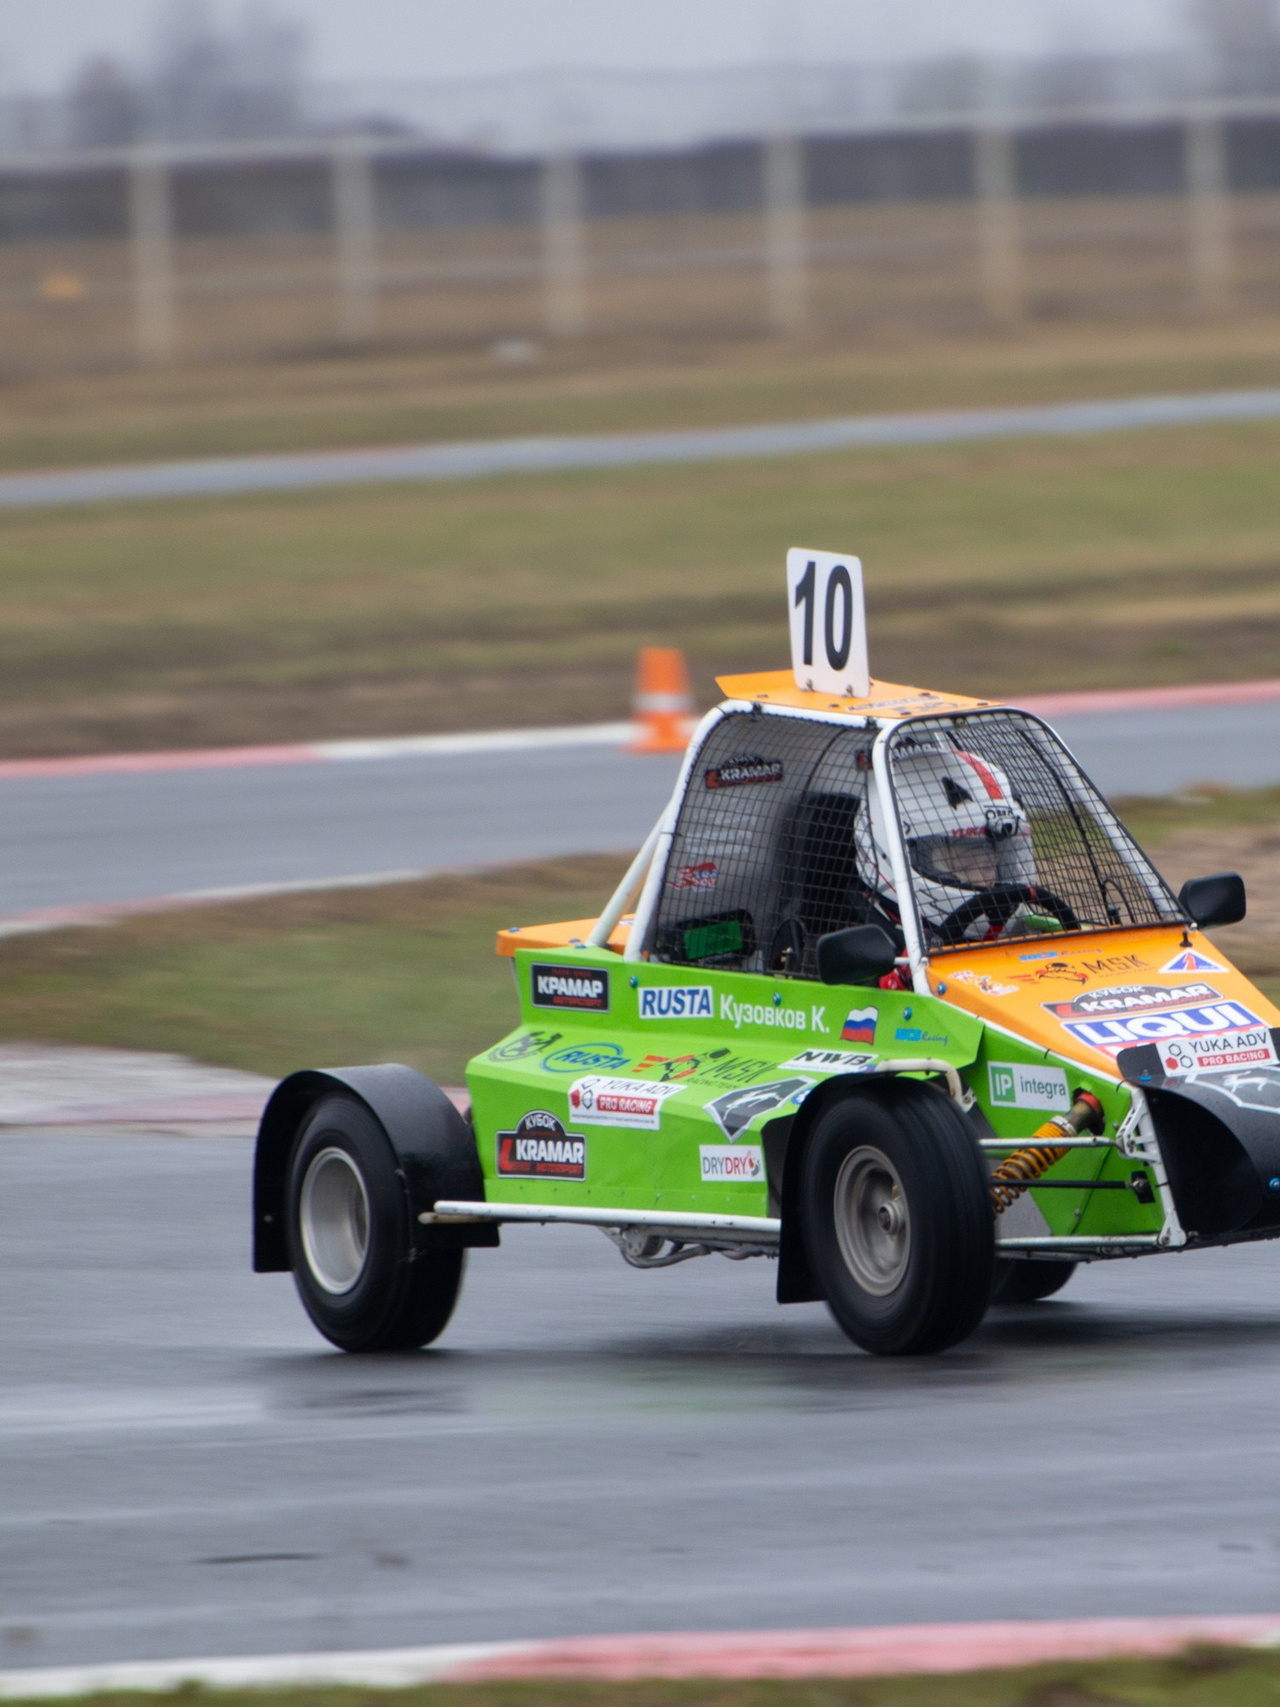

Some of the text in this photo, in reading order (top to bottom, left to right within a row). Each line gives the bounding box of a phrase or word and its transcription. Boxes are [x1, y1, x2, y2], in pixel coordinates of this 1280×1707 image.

[794, 561, 853, 671] 10
[721, 763, 780, 780] KRAMAR
[1081, 954, 1149, 974] MSK
[537, 976, 604, 998] КРАМАР
[641, 988, 711, 1015] RUSTA
[1080, 985, 1211, 1012] KRAMAR
[720, 993, 830, 1033] Кузовков К.
[1074, 1003, 1250, 1045] LIQUI
[1189, 1032, 1267, 1053] YUKA ADV
[553, 1050, 631, 1070] RUSTA
[793, 1051, 873, 1066] NWB
[1203, 1050, 1266, 1066] PRO RACING
[699, 1055, 777, 1083] MSK
[602, 1080, 682, 1096] YUKA ADV
[995, 1073, 1066, 1099] IP integra
[600, 1096, 652, 1113] PRO RACING
[525, 1114, 557, 1131] КУБОК
[516, 1139, 584, 1164] KRAMAR
